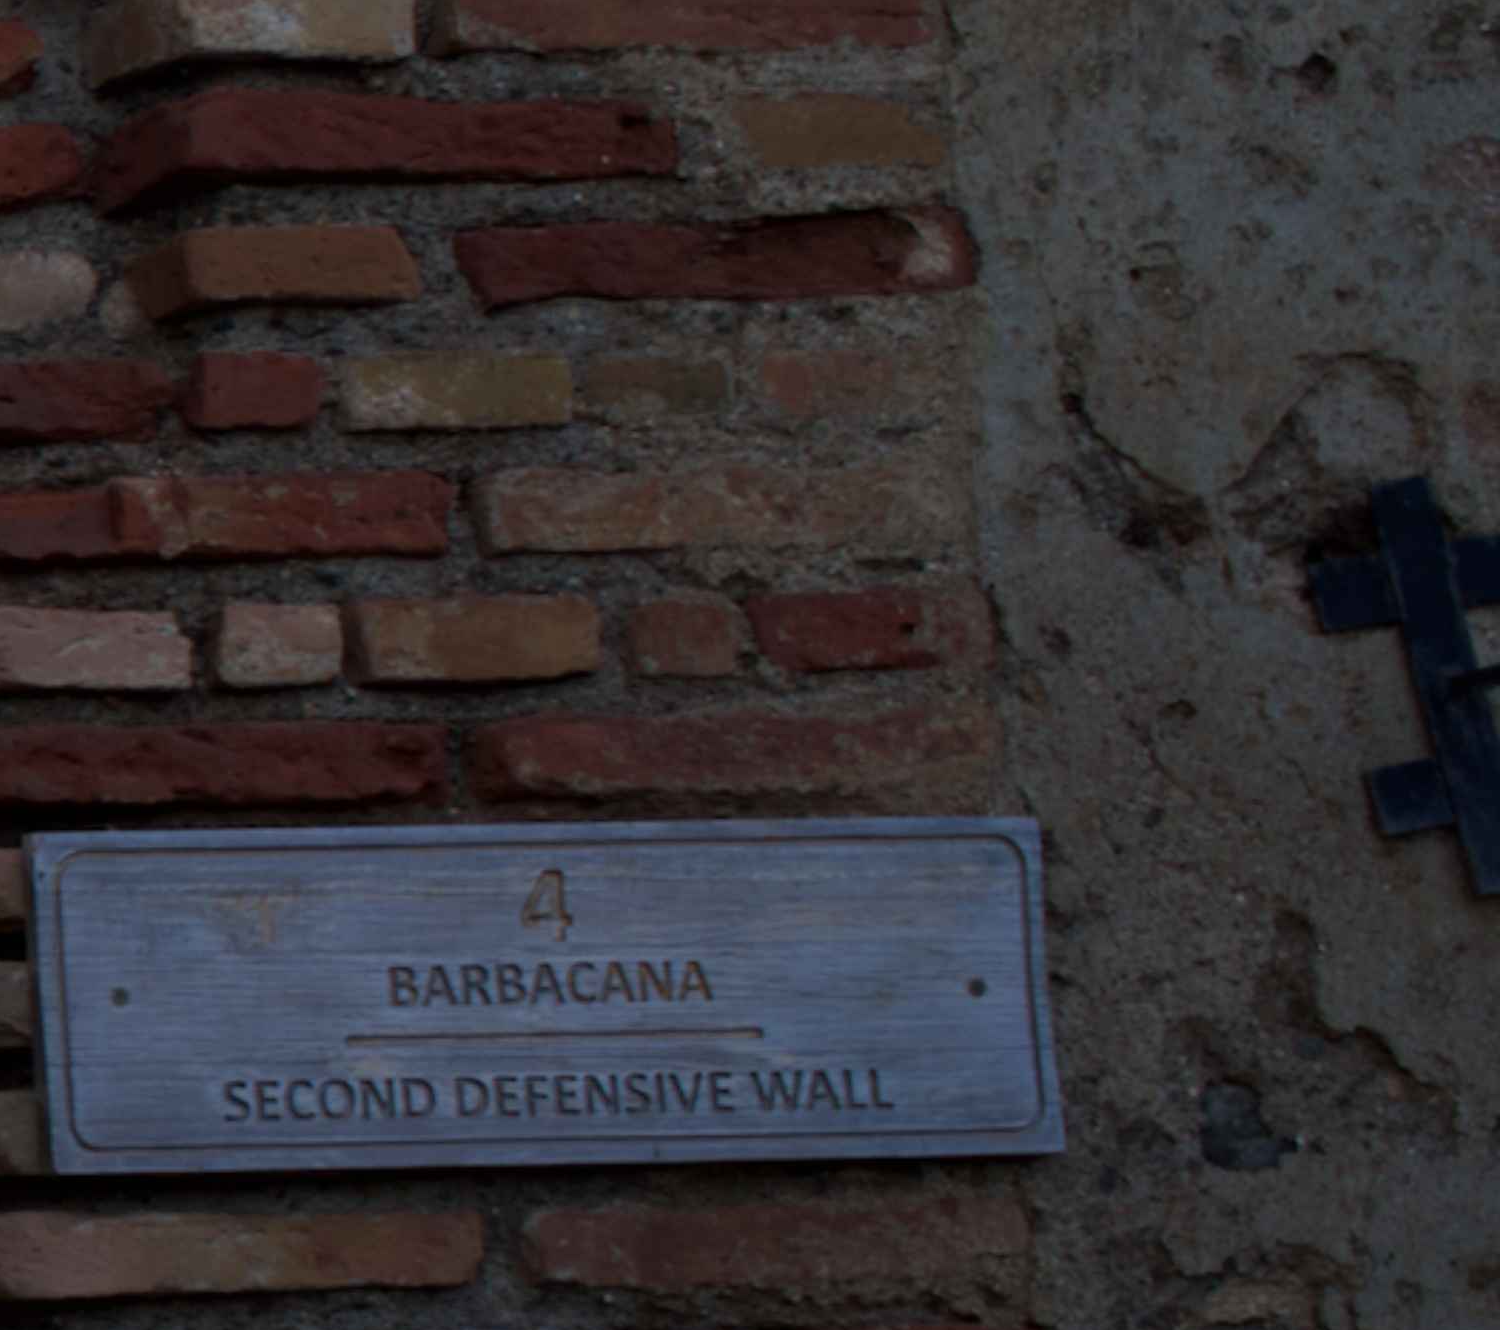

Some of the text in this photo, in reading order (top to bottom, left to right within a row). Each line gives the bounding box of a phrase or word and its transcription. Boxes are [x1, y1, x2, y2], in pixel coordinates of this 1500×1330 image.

[521, 867, 573, 943] 4
[387, 960, 714, 1007] BARBACANA
[224, 1068, 894, 1122] SECOND DEFENSIVE WALL
